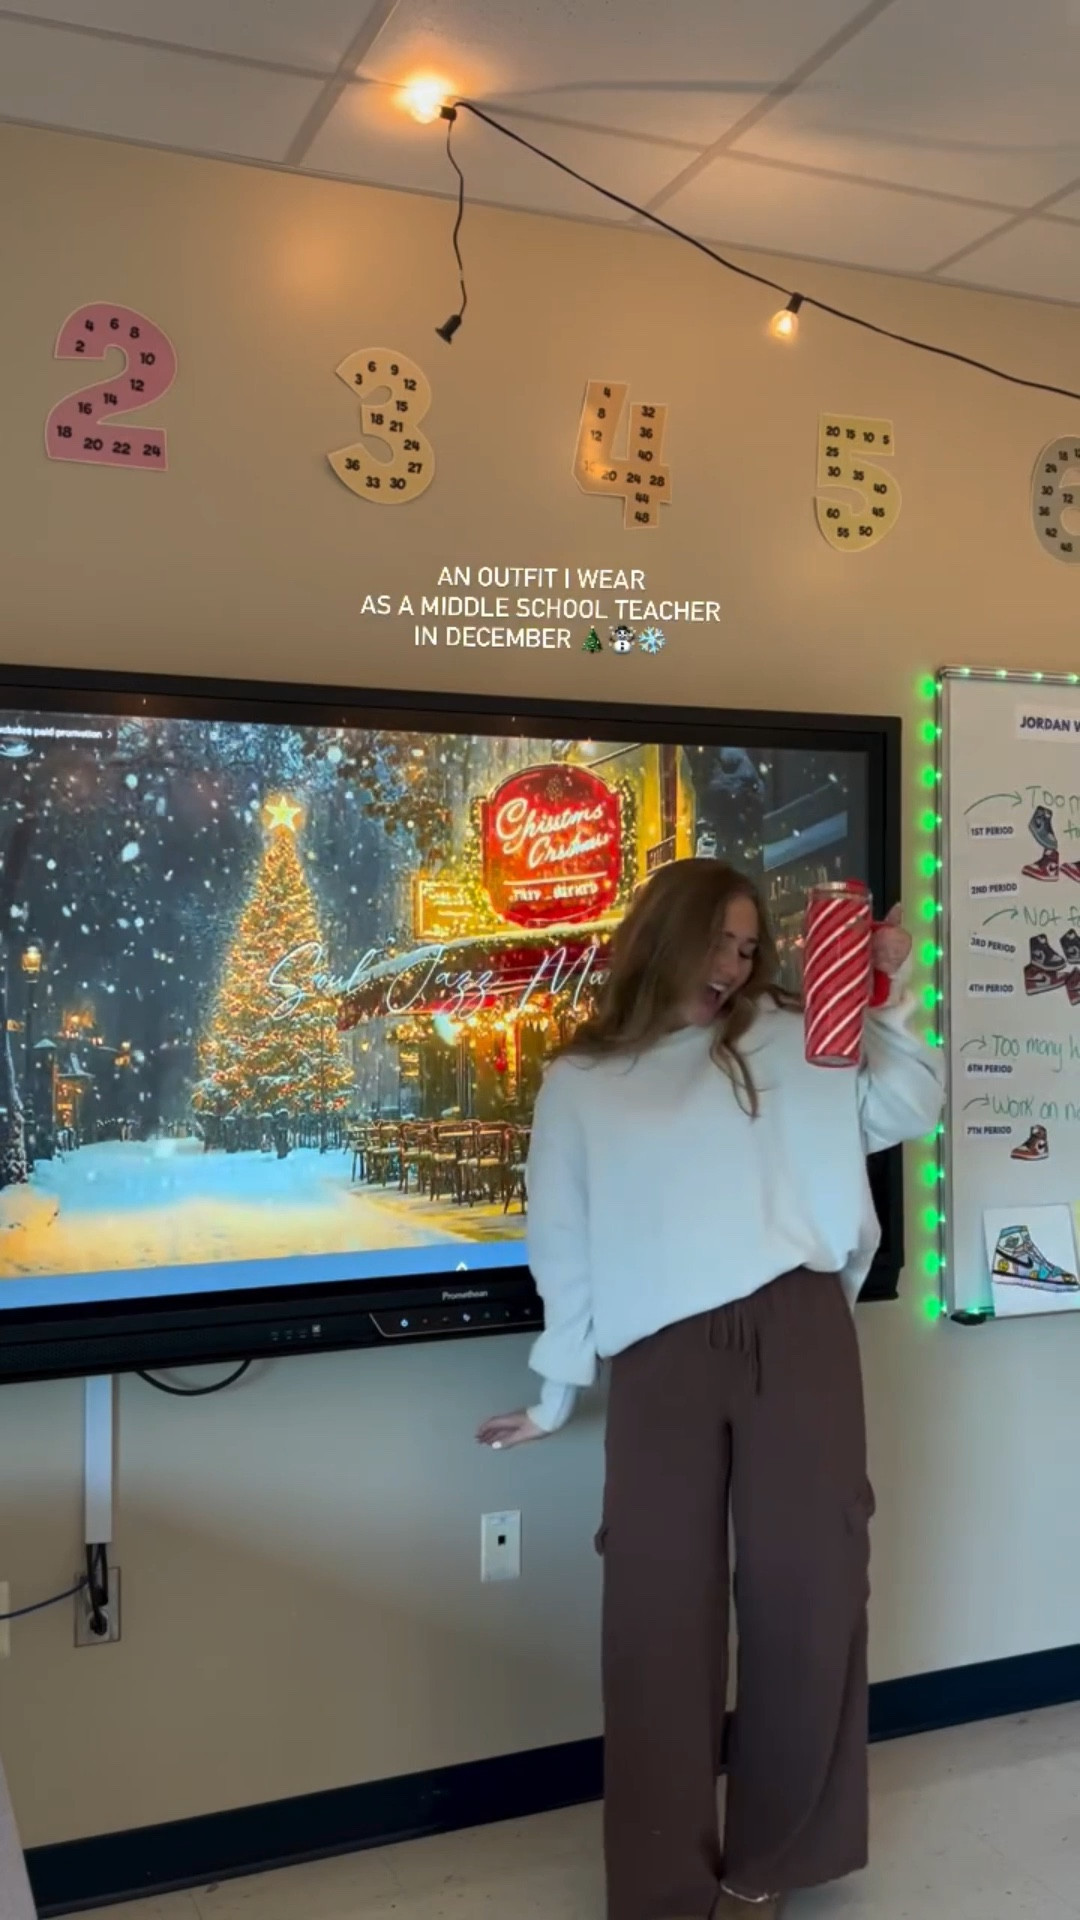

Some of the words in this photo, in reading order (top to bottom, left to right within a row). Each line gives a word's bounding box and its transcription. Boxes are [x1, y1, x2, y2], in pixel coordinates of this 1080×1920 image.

[85, 319, 94, 332] 4
[110, 318, 119, 330] 6
[129, 326, 140, 339] 8
[75, 340, 85, 352] 2
[140, 352, 155, 365] 10
[355, 373, 363, 385] 3
[367, 361, 376, 372] 6
[390, 364, 399, 376] 9
[403, 378, 417, 391] 12
[129, 379, 144, 392] 12
[603, 386, 611, 398] 4
[78, 402, 92, 415] 16
[103, 392, 118, 406] 14
[396, 400, 408, 412] 15
[597, 407, 606, 419] 8
[641, 405, 656, 418] 32
[370, 413, 384, 425] 18
[389, 420, 403, 433] 21
[639, 426, 653, 439] 36
[826, 425, 840, 437] 20
[845, 428, 856, 440] 15
[863, 432, 875, 443] 10
[882, 434, 890, 445] 5
[56, 425, 72, 438] 18
[83, 437, 103, 451] 20
[112, 441, 131, 455] 22
[142, 444, 161, 457] 24
[403, 439, 420, 451] 24
[637, 449, 653, 462] 40
[825, 446, 839, 457] 25
[344, 458, 360, 471] 36
[365, 476, 380, 489] 33
[389, 477, 406, 490] 30
[407, 462, 423, 474] 27
[827, 466, 841, 478] 30
[852, 470, 864, 481] 35
[626, 472, 641, 485] 24
[649, 474, 665, 487] 28
[873, 483, 887, 495] 40
[1041, 485, 1054, 496] 30
[635, 492, 649, 504] 44
[634, 511, 649, 524] 48
[826, 507, 840, 520] 60
[872, 506, 885, 518] 45
[837, 526, 850, 538] 55
[858, 525, 873, 537] 50
[1020, 716, 1070, 732] JORDAN
[55, 729, 103, 739] promotion
[971, 826, 984, 836] 1ST
[985, 825, 1014, 835] PERIOD
[971, 886, 988, 895] 2ND
[989, 883, 1018, 894] PERIOD
[970, 937, 986, 948] 3RD
[987, 941, 1016, 954] PERIOD
[268, 941, 378, 1021] Soul
[386, 944, 503, 1020] Jazz
[969, 983, 984, 992] 4TH
[985, 983, 1014, 993] PERIOD
[991, 1034, 1021, 1057] Too
[967, 1064, 983, 1072] 6TH
[984, 1064, 1013, 1073] PERIOD
[967, 1126, 982, 1135] 7TH
[983, 1126, 1012, 1135] PERIOD
[442, 1289, 488, 1301] Promethean
